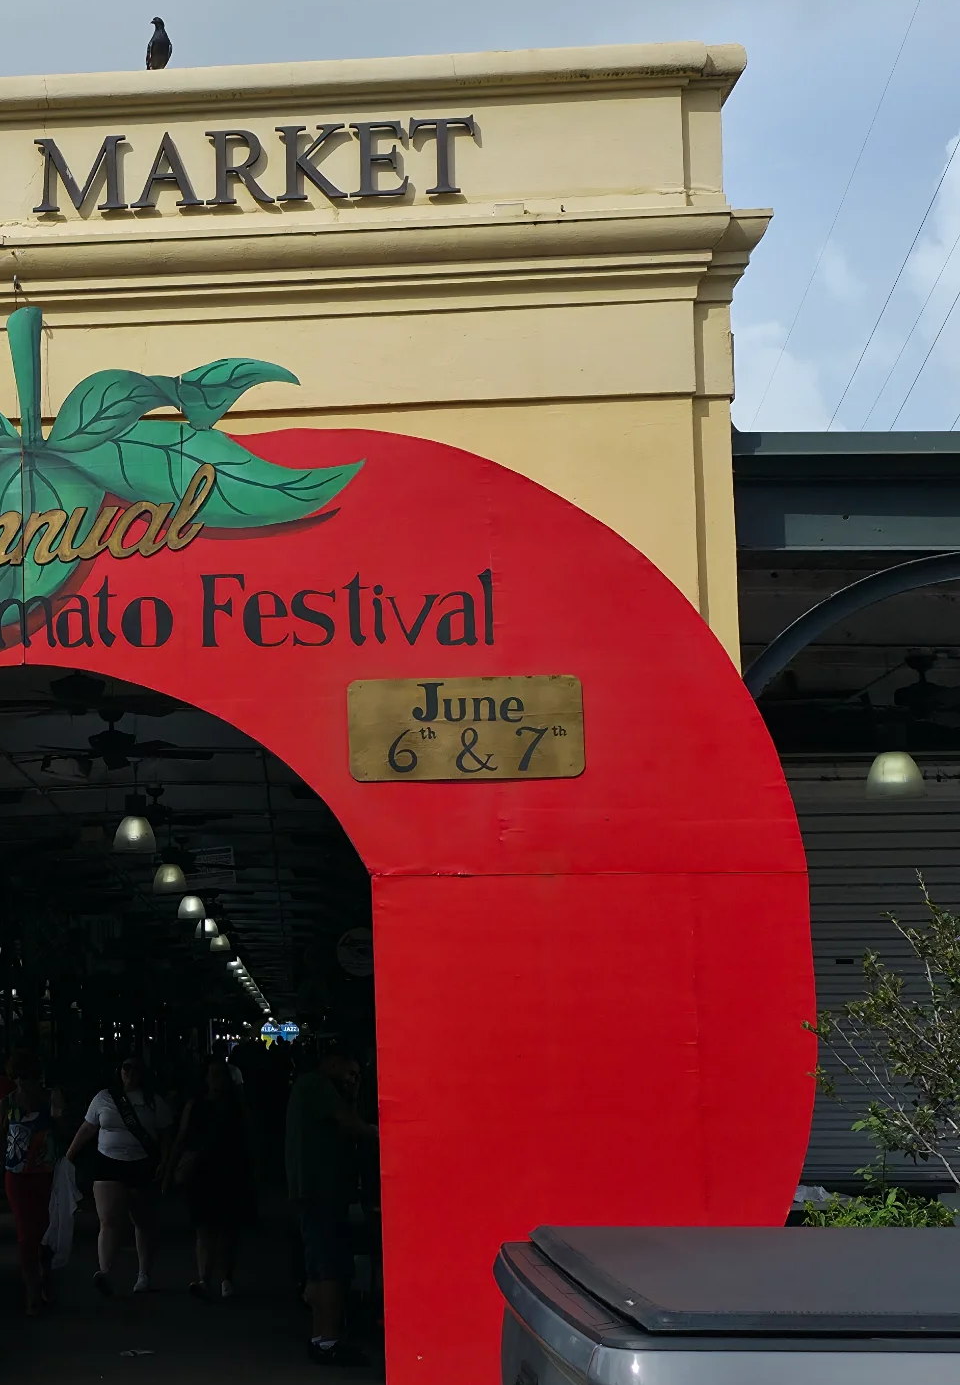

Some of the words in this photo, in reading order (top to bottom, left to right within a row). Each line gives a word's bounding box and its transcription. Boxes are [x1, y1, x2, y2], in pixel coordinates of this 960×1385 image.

[33, 114, 476, 213] MARKET
[200, 568, 495, 648] Festival
[412, 682, 525, 723] June
[455, 727, 498, 773] &
